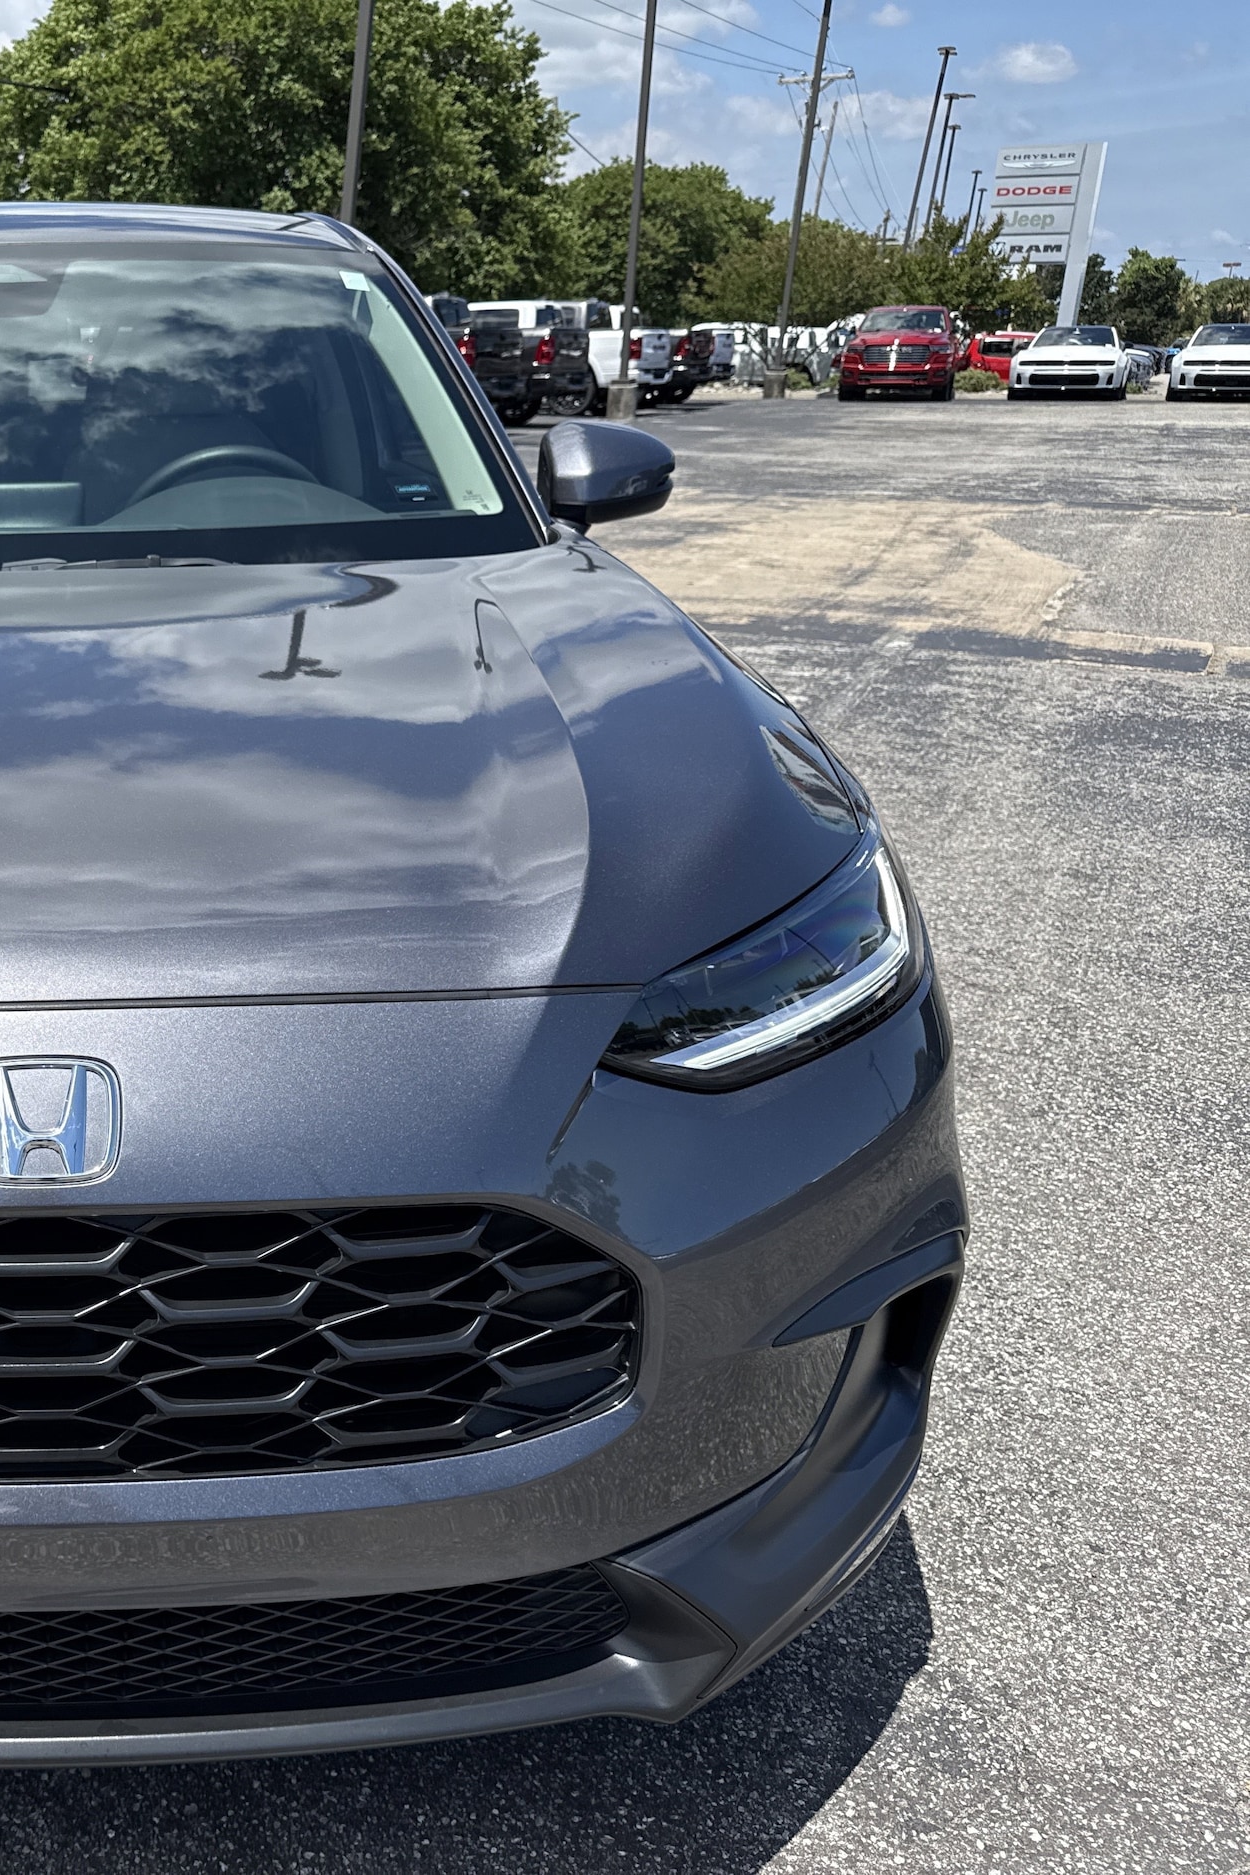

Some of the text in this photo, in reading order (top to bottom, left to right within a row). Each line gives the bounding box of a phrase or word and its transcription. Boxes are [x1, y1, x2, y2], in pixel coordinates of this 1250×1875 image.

[1003, 152, 1077, 161] CHRYSLER
[996, 185, 1073, 197] DODGE
[1004, 210, 1055, 230] Jeep
[1009, 244, 1063, 254] RAM
